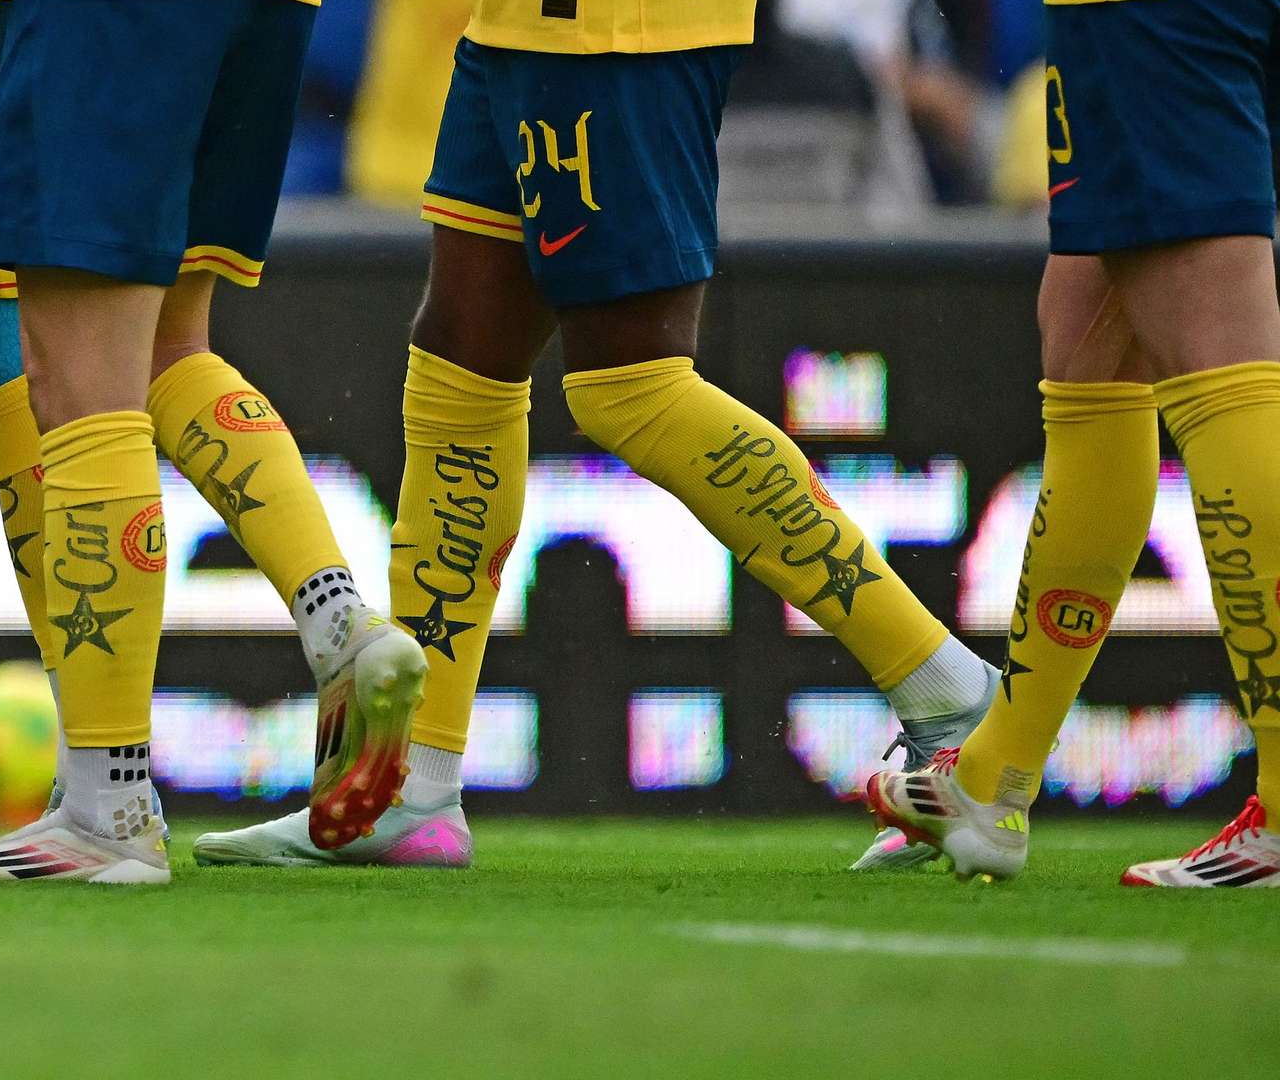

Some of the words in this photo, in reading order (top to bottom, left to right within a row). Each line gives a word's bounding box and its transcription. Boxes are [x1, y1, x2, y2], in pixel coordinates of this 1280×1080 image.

[517, 111, 602, 218] 24
[434, 443, 500, 491] Jr.
[413, 491, 488, 603] Carl's
[1057, 604, 1095, 634] CA
